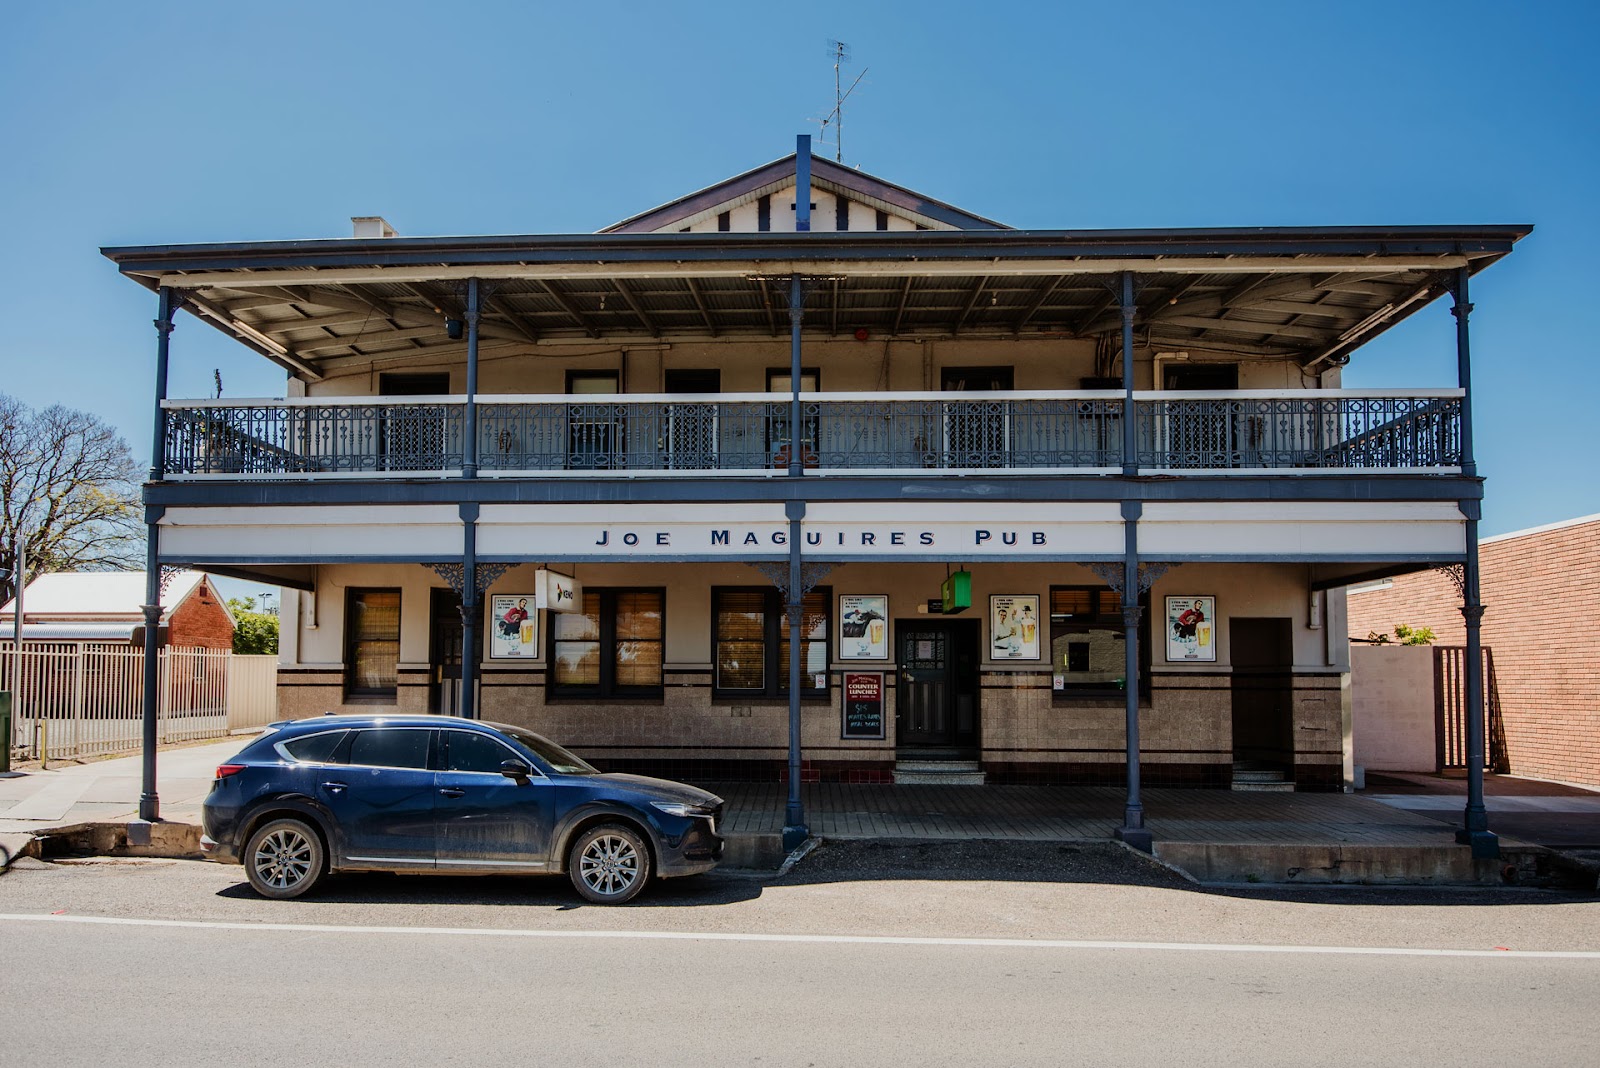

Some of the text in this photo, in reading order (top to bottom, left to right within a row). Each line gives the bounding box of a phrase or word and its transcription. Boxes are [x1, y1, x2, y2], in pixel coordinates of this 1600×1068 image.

[595, 529, 1048, 546] JOE MAGUIRES PUB
[563, 590, 573, 600] KENO
